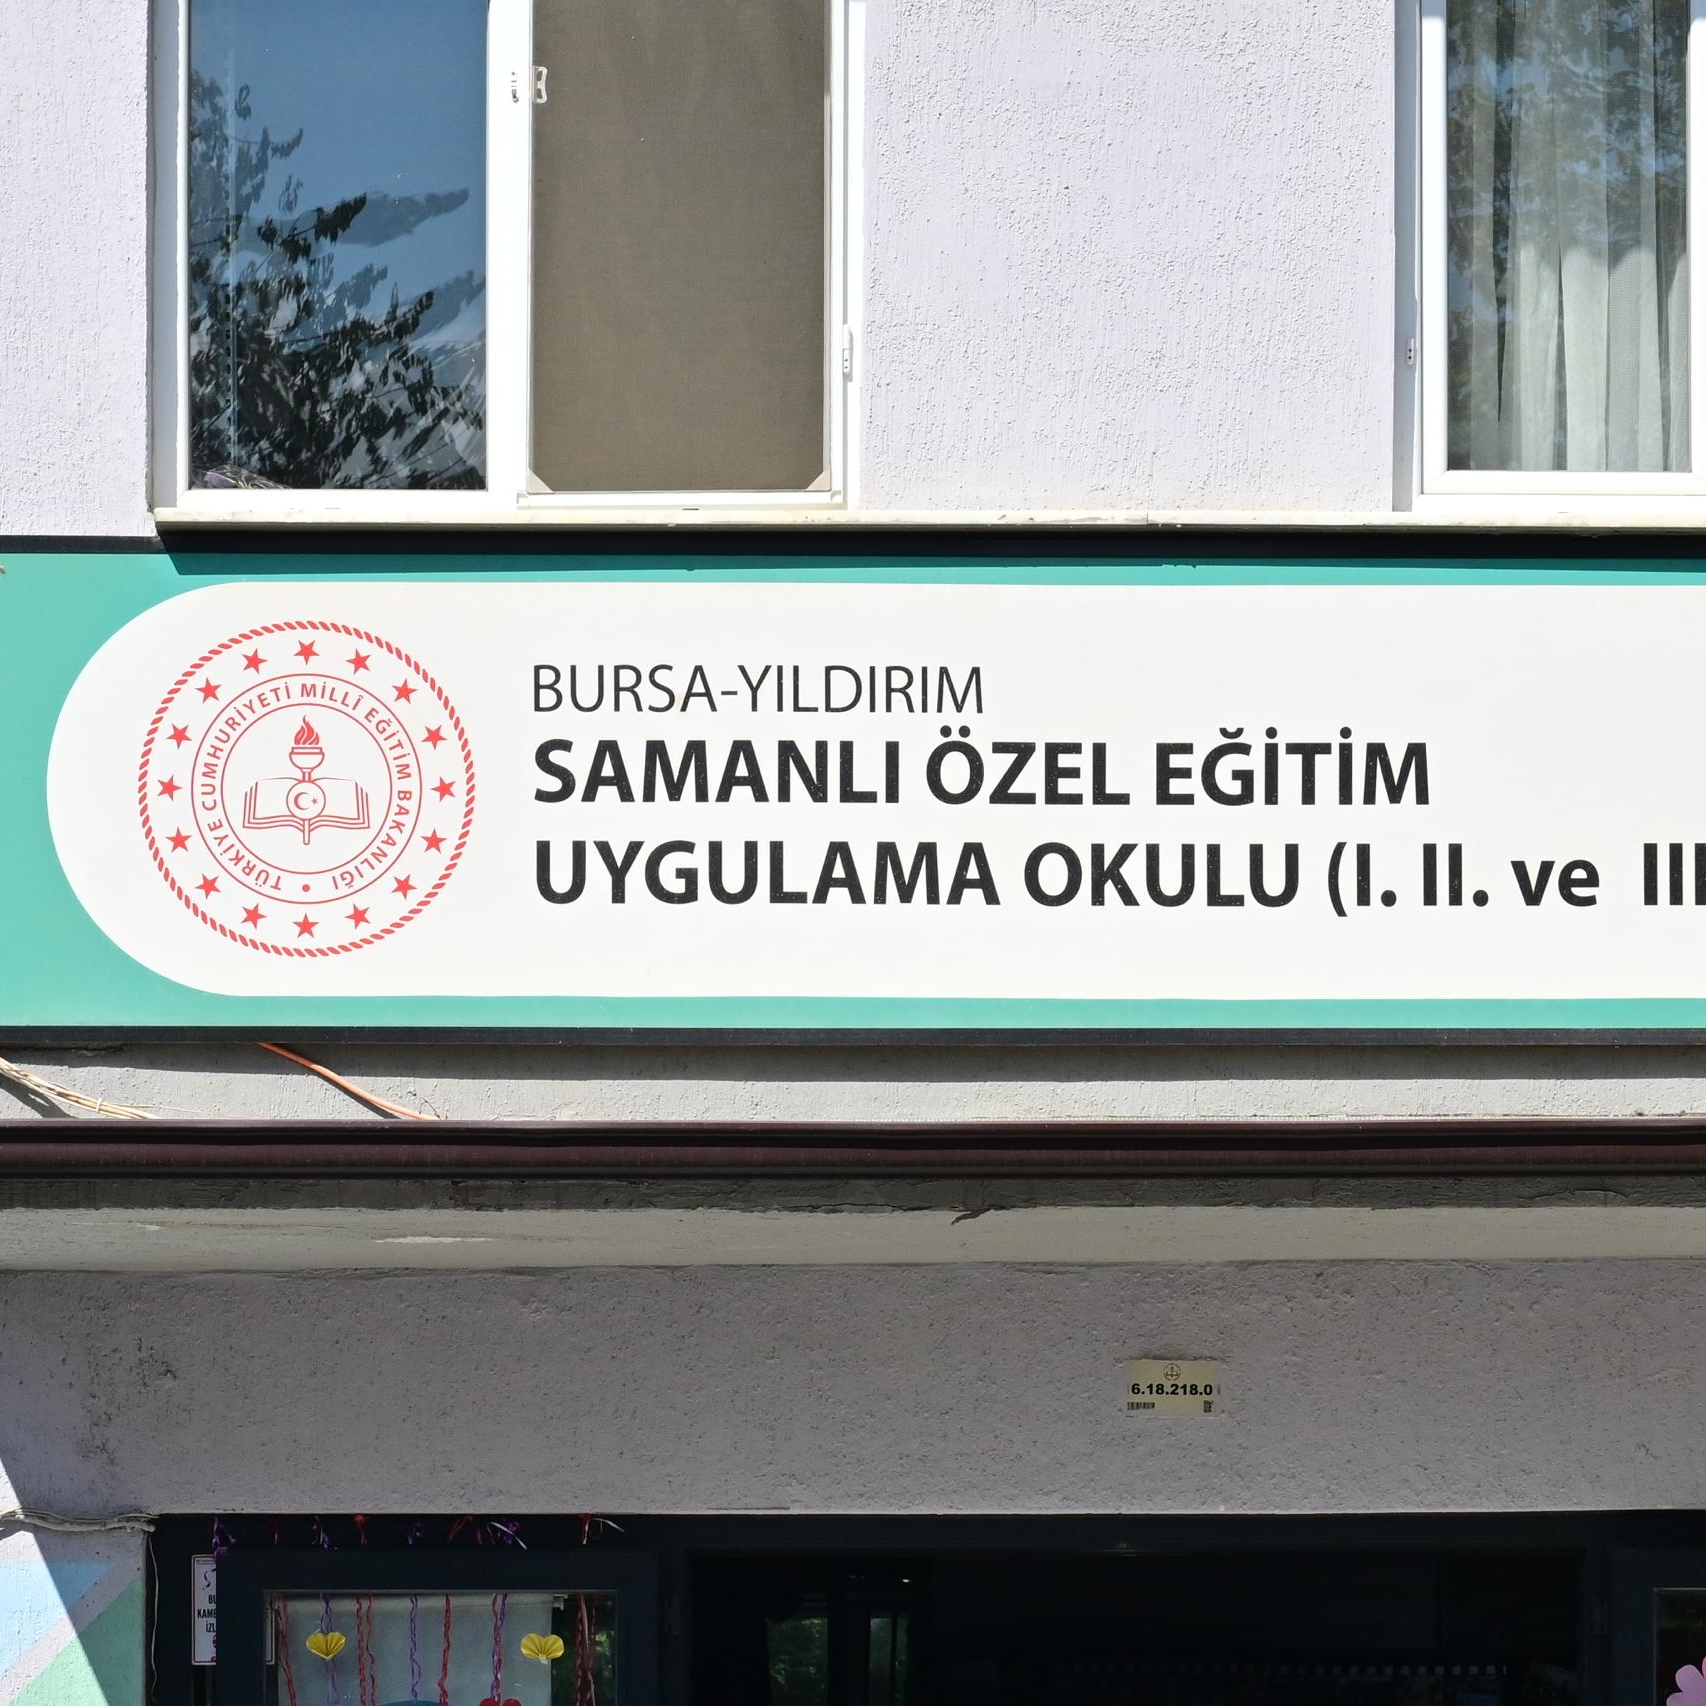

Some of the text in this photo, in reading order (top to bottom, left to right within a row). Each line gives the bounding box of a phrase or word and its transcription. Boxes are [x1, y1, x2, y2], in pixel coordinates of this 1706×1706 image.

[534, 665, 982, 713] BURSA-YILDIRIM
[201, 681, 291, 811] CUMHURİYETİ
[364, 706, 412, 781] EĞİTİM
[535, 726, 1429, 806] SAMANLI ÖZEL EĞİTİM
[207, 819, 283, 891] TÜRKİYE
[331, 790, 413, 890] BAKANLIĞI
[537, 841, 1000, 905] UYGULAMA
[1025, 843, 1298, 907] OKULU
[1328, 842, 1396, 917] (I.
[1423, 844, 1488, 906] II.
[1511, 860, 1599, 906] ve
[1131, 1383, 1213, 1396] 6.18.218.0
